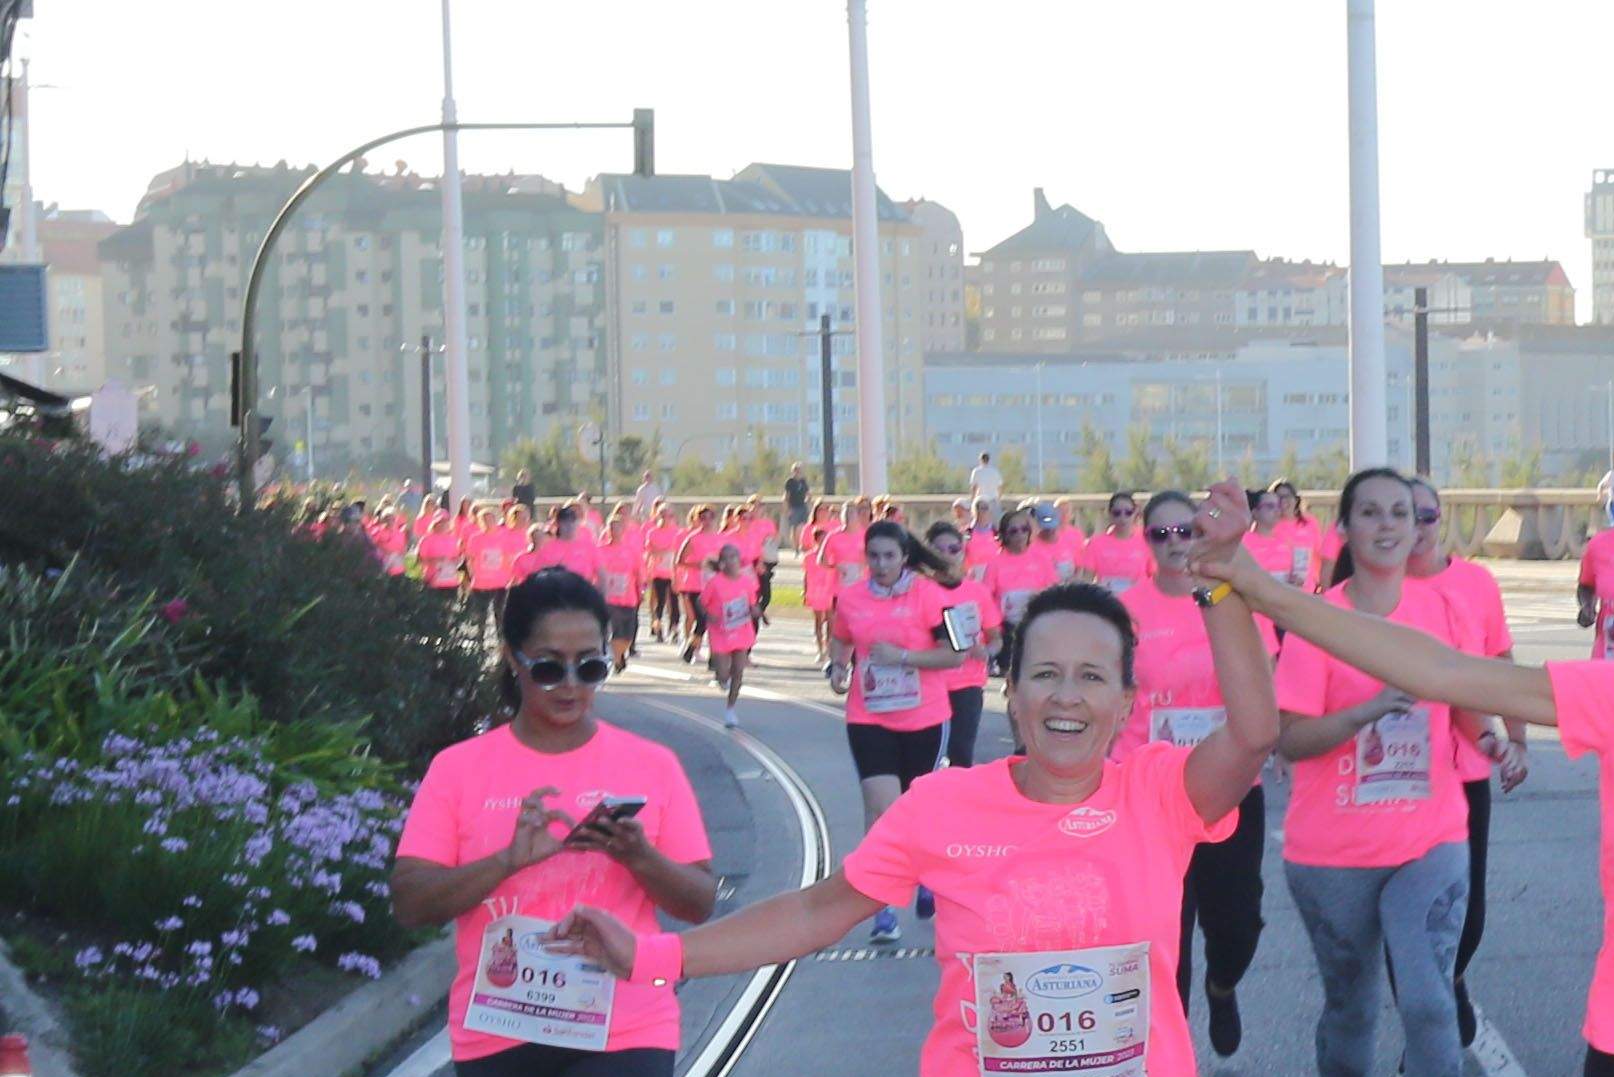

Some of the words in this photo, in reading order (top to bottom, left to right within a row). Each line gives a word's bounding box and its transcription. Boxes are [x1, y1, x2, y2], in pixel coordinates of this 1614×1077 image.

[521, 966, 567, 988] 016
[1031, 979, 1098, 992] ASTURIANA
[526, 990, 557, 1004] 6399
[1037, 1009, 1097, 1033] 016
[1049, 1039, 1086, 1053] 2551
[1000, 1057, 1048, 1070] CARRERA
[1049, 1057, 1064, 1069] DE
[1065, 1056, 1079, 1068] LA
[1080, 1054, 1115, 1067] MUJER
